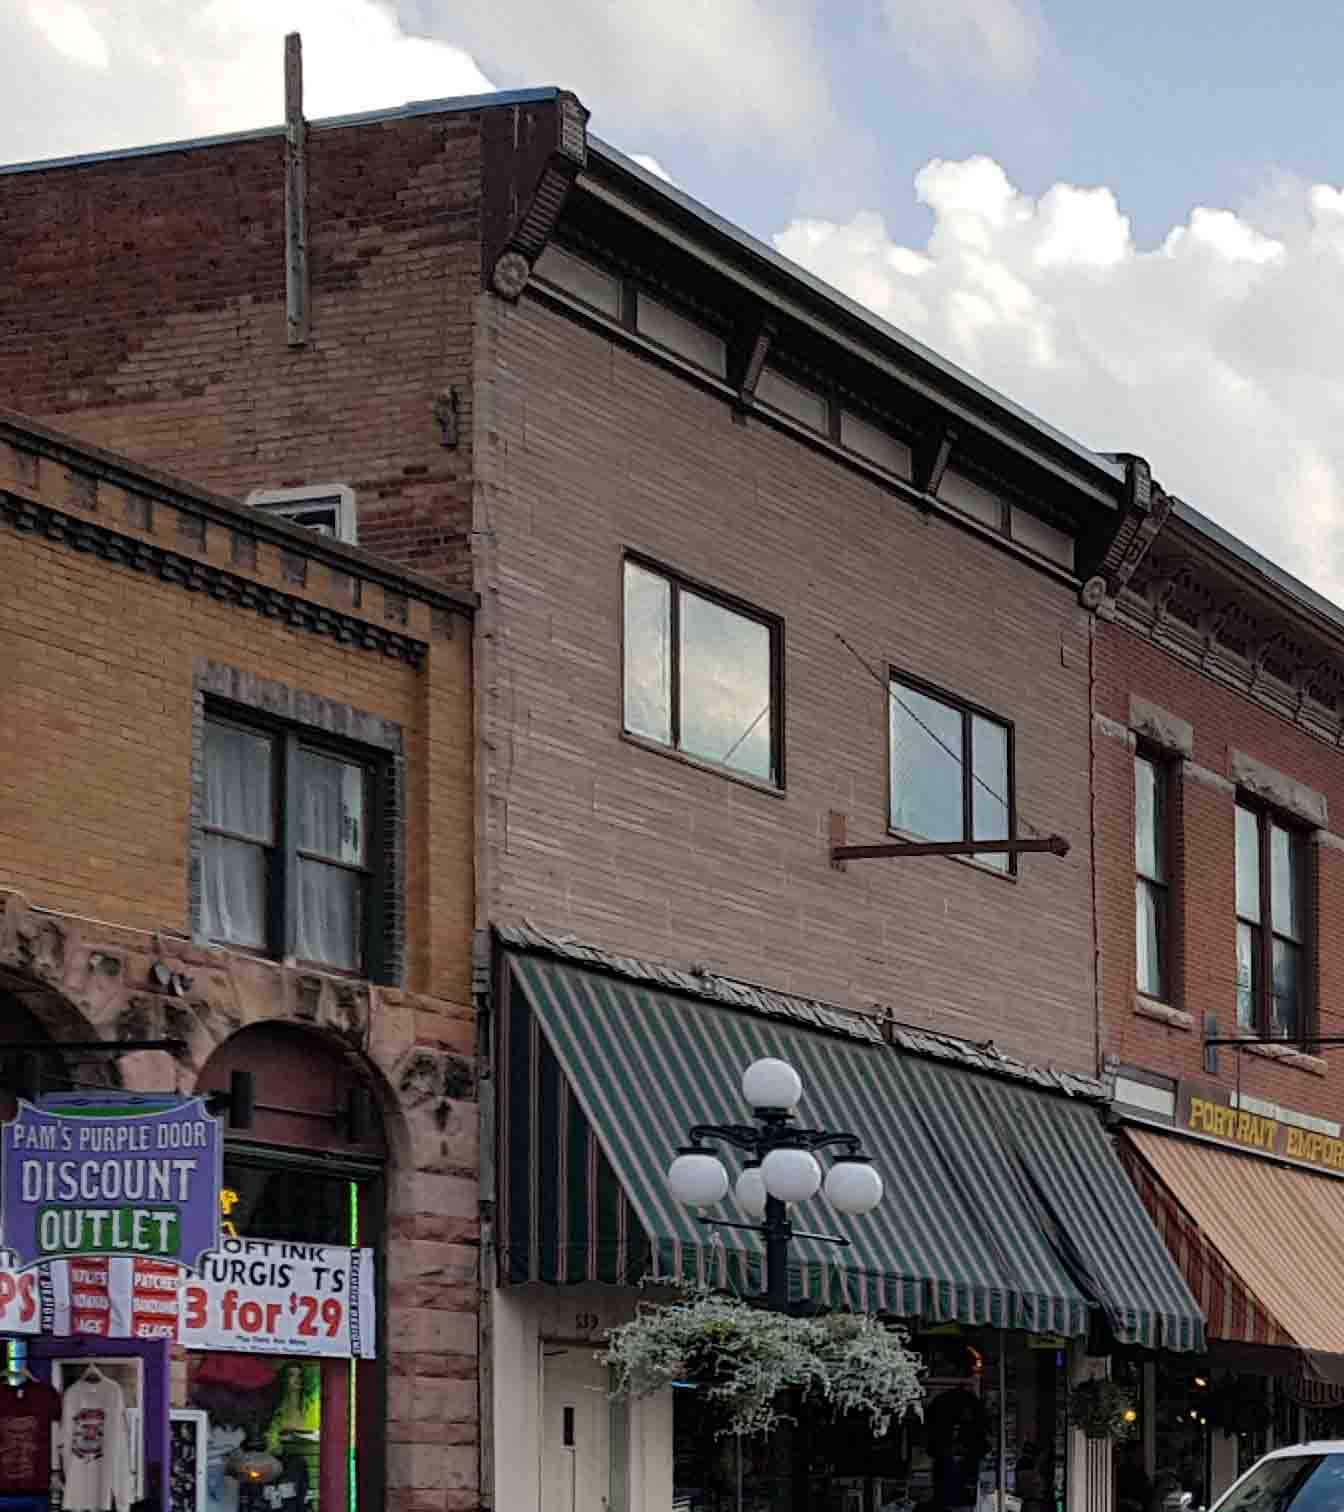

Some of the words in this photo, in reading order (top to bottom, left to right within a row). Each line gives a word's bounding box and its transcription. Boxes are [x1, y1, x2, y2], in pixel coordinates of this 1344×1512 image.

[13, 1119, 72, 1151] PAM'S
[80, 1125, 151, 1151] PURPLE
[157, 1120, 207, 1149] DOOR
[1189, 1096, 1278, 1151] PORTRAIT
[21, 1159, 198, 1202] DISCOUNT
[40, 1208, 177, 1252] OUTLET
[224, 1239, 275, 1257] OFT
[278, 1244, 328, 1263] INK
[185, 1251, 293, 1289] TURGIS
[185, 1286, 209, 1329] 3
[221, 1288, 283, 1334] for
[289, 1291, 343, 1338] $29
